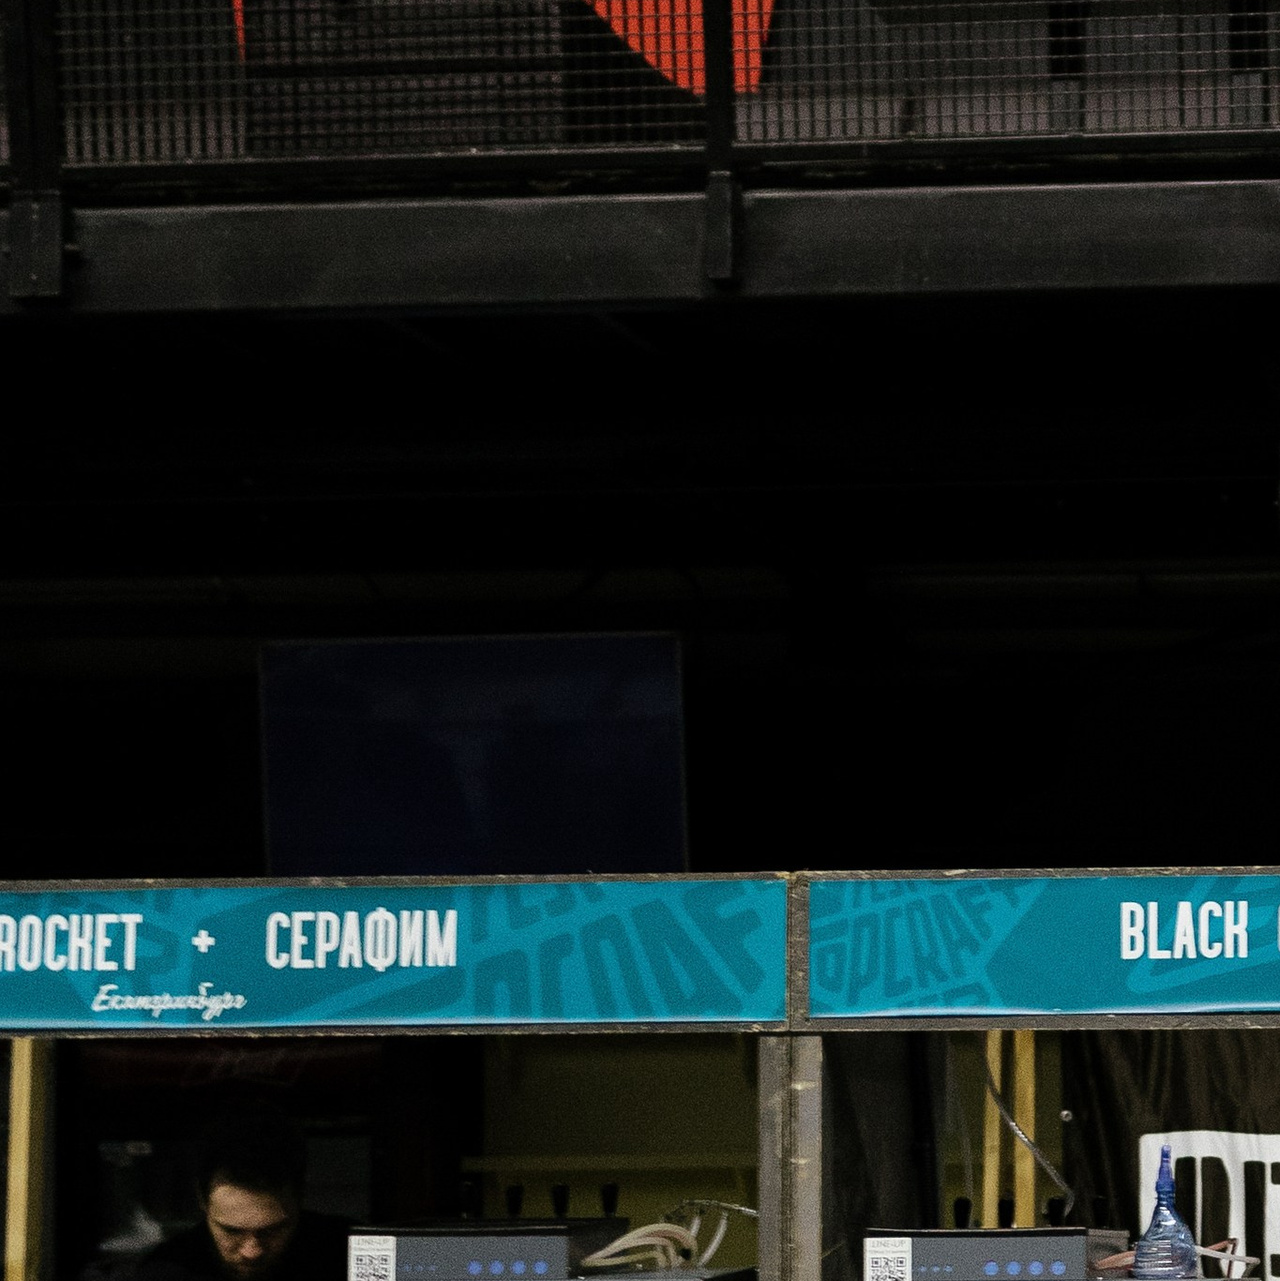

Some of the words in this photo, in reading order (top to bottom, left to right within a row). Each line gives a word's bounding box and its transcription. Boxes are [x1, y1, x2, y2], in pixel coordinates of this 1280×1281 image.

[0, 913, 143, 972] ROCKET
[265, 907, 458, 972] СЕРАФИМ
[1120, 900, 1249, 960] BLACK
